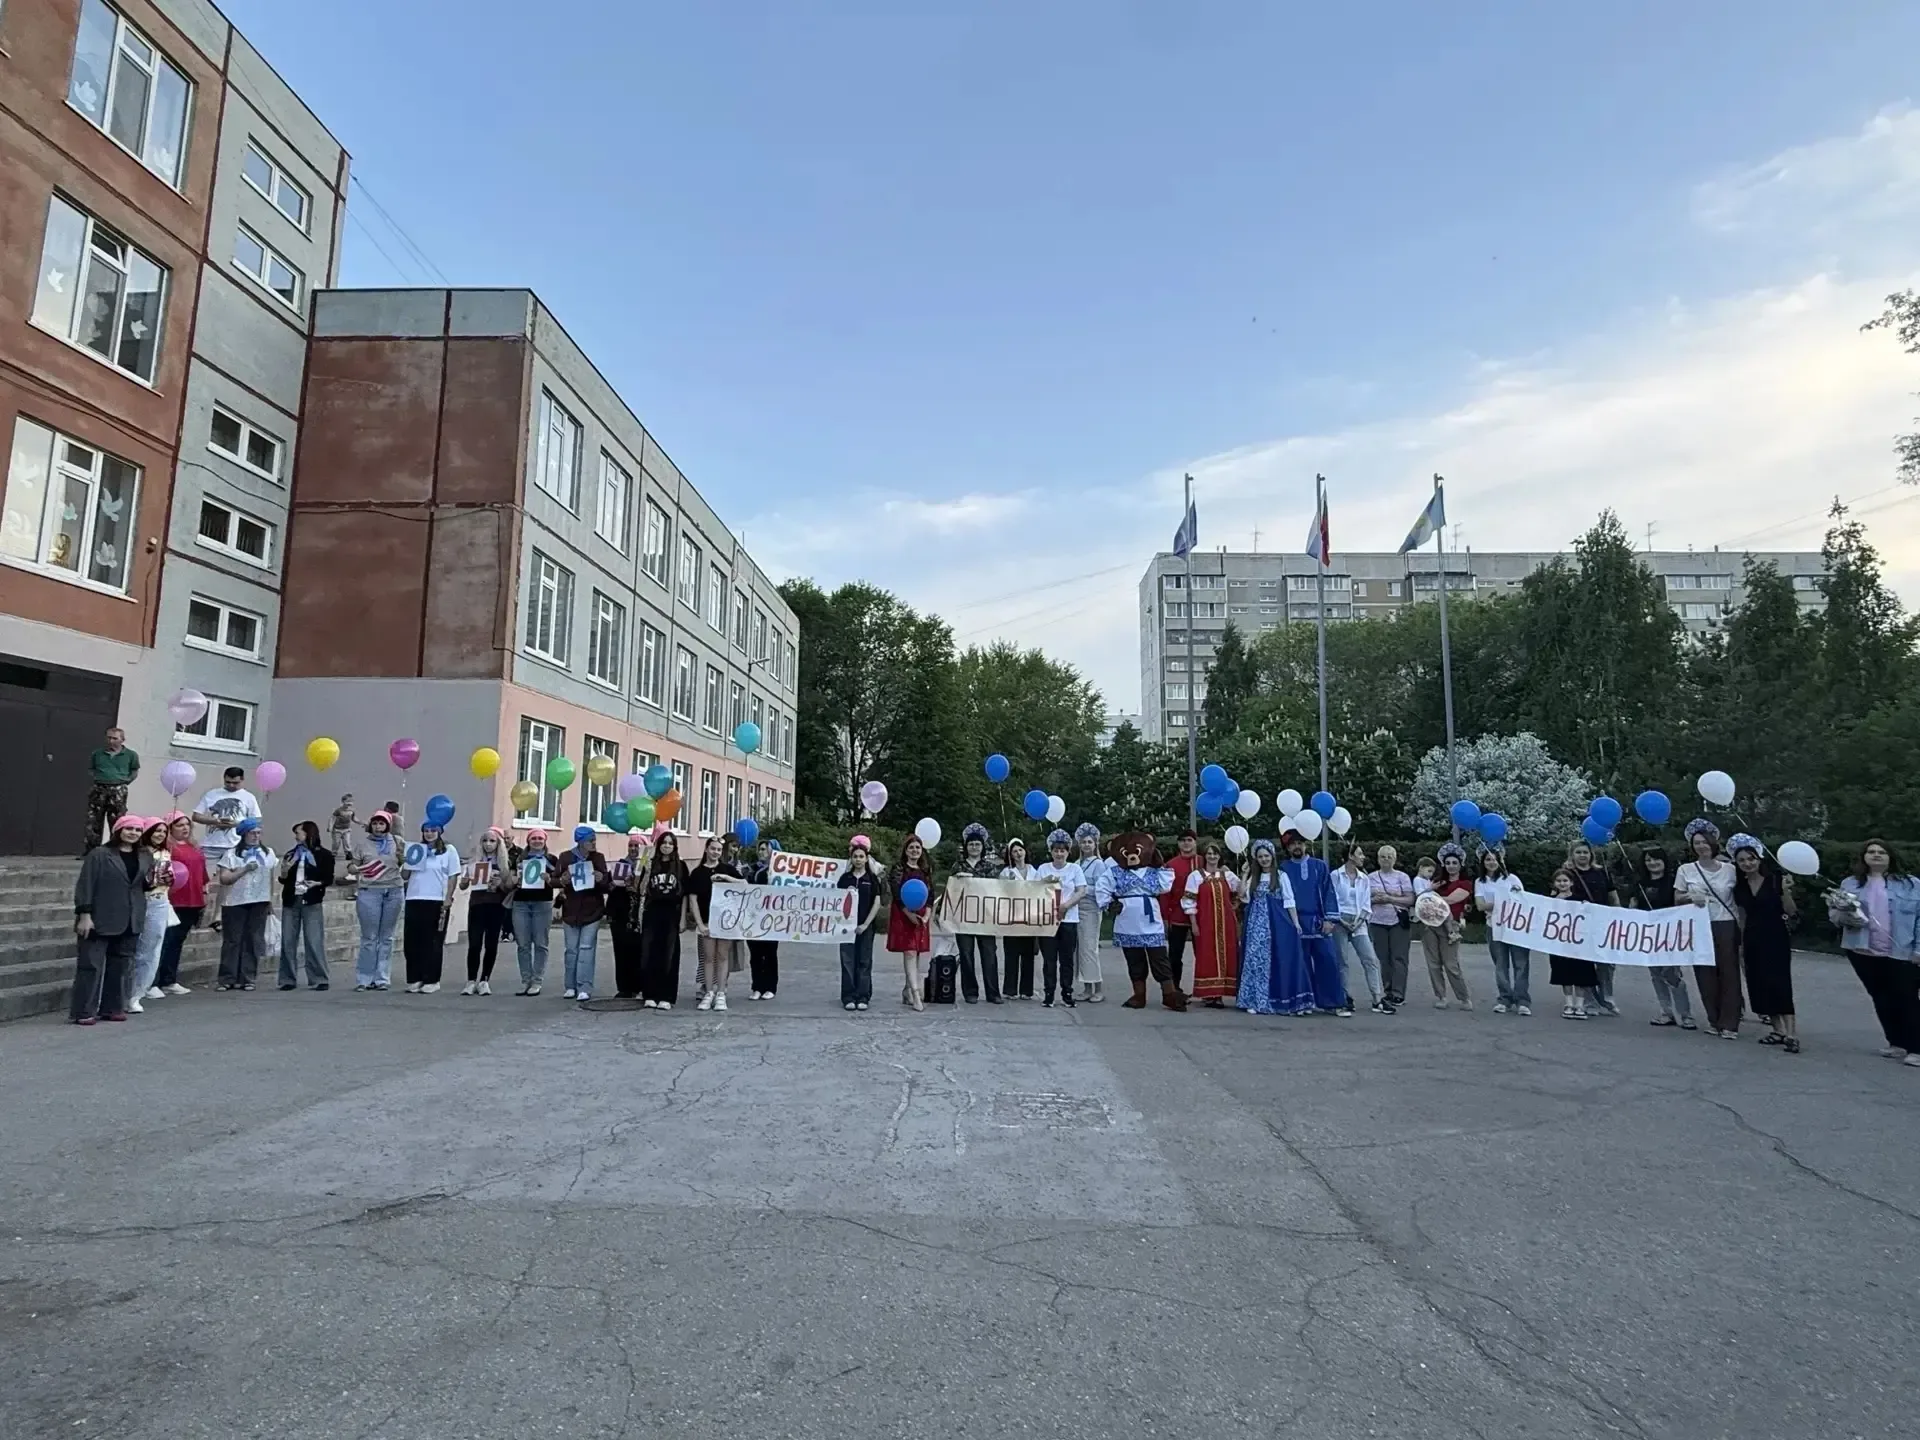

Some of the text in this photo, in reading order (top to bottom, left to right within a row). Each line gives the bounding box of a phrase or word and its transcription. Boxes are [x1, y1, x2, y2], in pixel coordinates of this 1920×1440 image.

[773, 854, 838, 879] СУПЕР
[720, 887, 842, 937] Классные
[1495, 900, 1535, 933] МЫ
[1598, 918, 1695, 953] ЛЮБИМ
